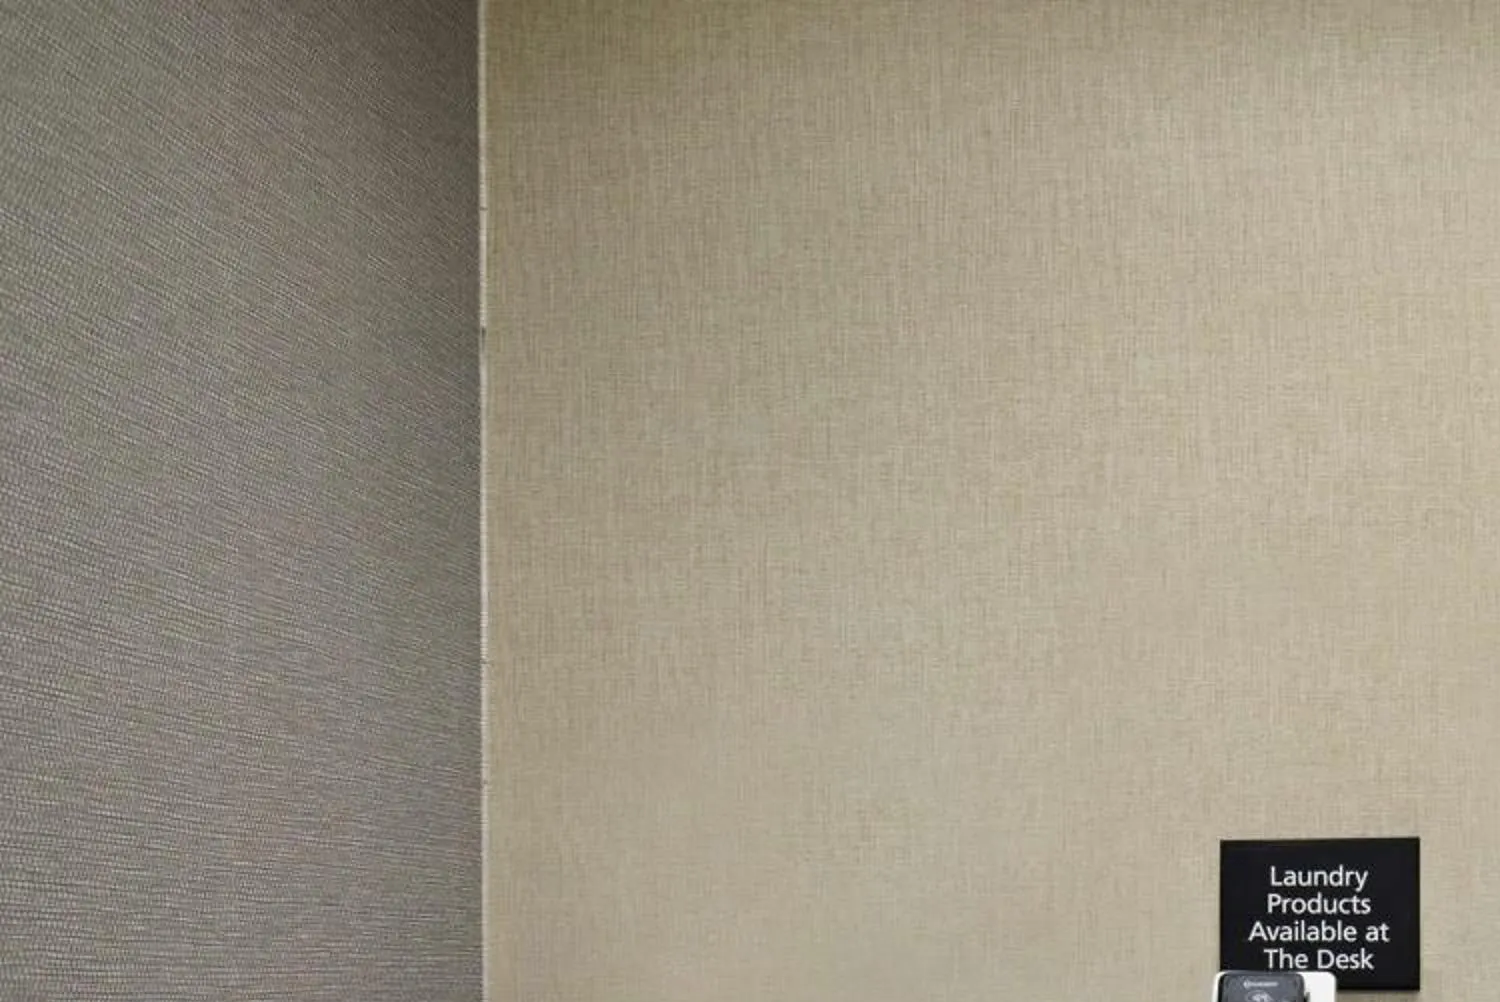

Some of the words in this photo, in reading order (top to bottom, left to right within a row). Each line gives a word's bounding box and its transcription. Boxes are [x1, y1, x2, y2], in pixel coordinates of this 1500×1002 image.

[1269, 864, 1369, 893] Laundry
[1267, 891, 1372, 915] Products
[1248, 919, 1358, 943] Available
[1365, 922, 1391, 943] at
[1263, 947, 1309, 970] The
[1316, 947, 1375, 970] Desk
